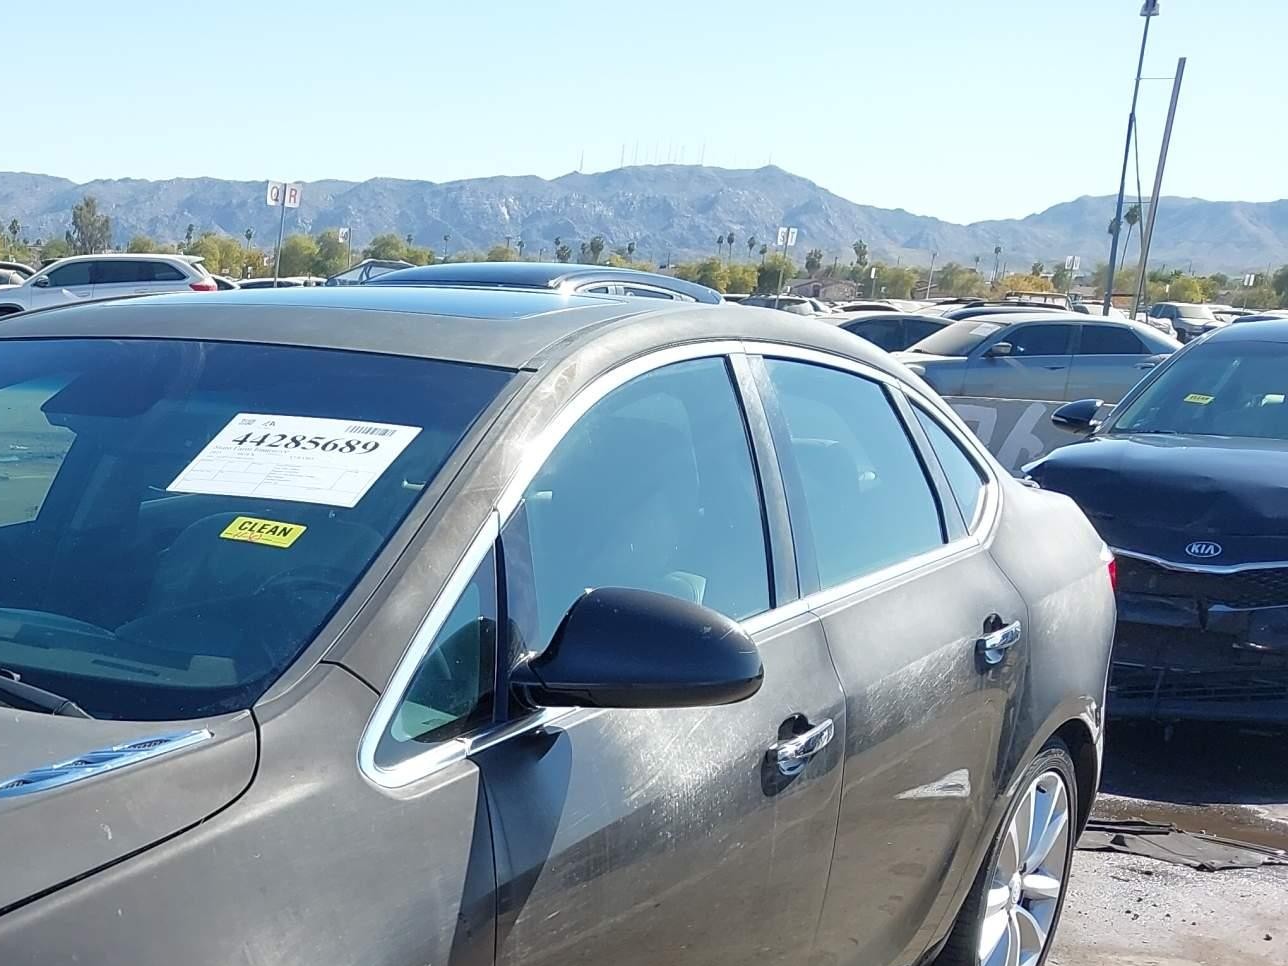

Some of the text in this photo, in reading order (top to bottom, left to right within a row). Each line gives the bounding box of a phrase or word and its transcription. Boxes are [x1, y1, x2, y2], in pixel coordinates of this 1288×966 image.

[270, 186, 280, 202] Q
[288, 188, 298, 204] R
[232, 431, 380, 455] 44285689
[238, 520, 293, 537] CLEAN
[1190, 543, 1215, 555] KIA
